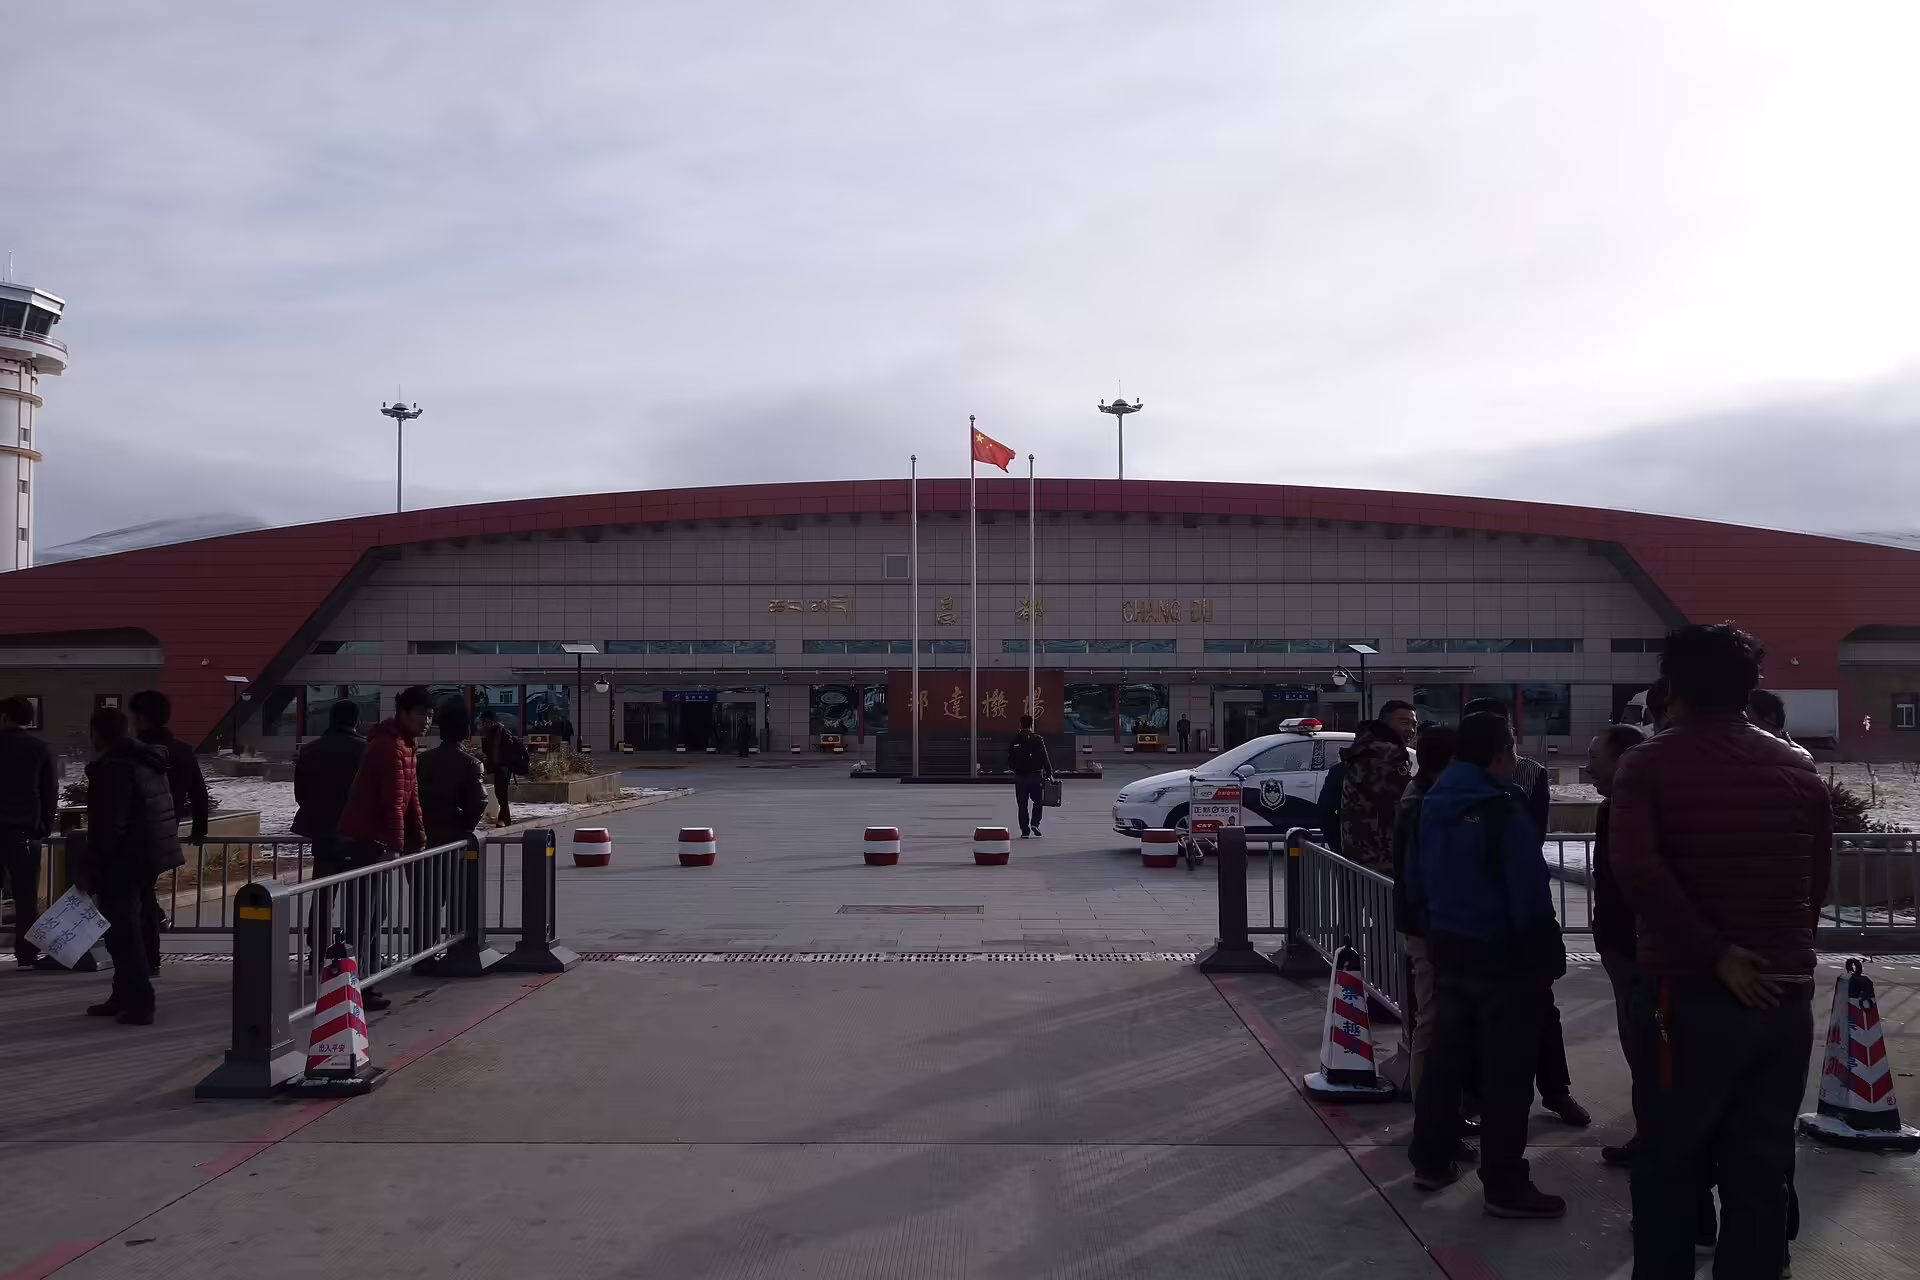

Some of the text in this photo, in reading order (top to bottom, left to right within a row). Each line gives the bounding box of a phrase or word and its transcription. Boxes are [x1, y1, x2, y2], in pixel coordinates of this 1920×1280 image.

[1122, 598, 1213, 623] CHANG DU
[318, 1044, 345, 1053] 出入平安
